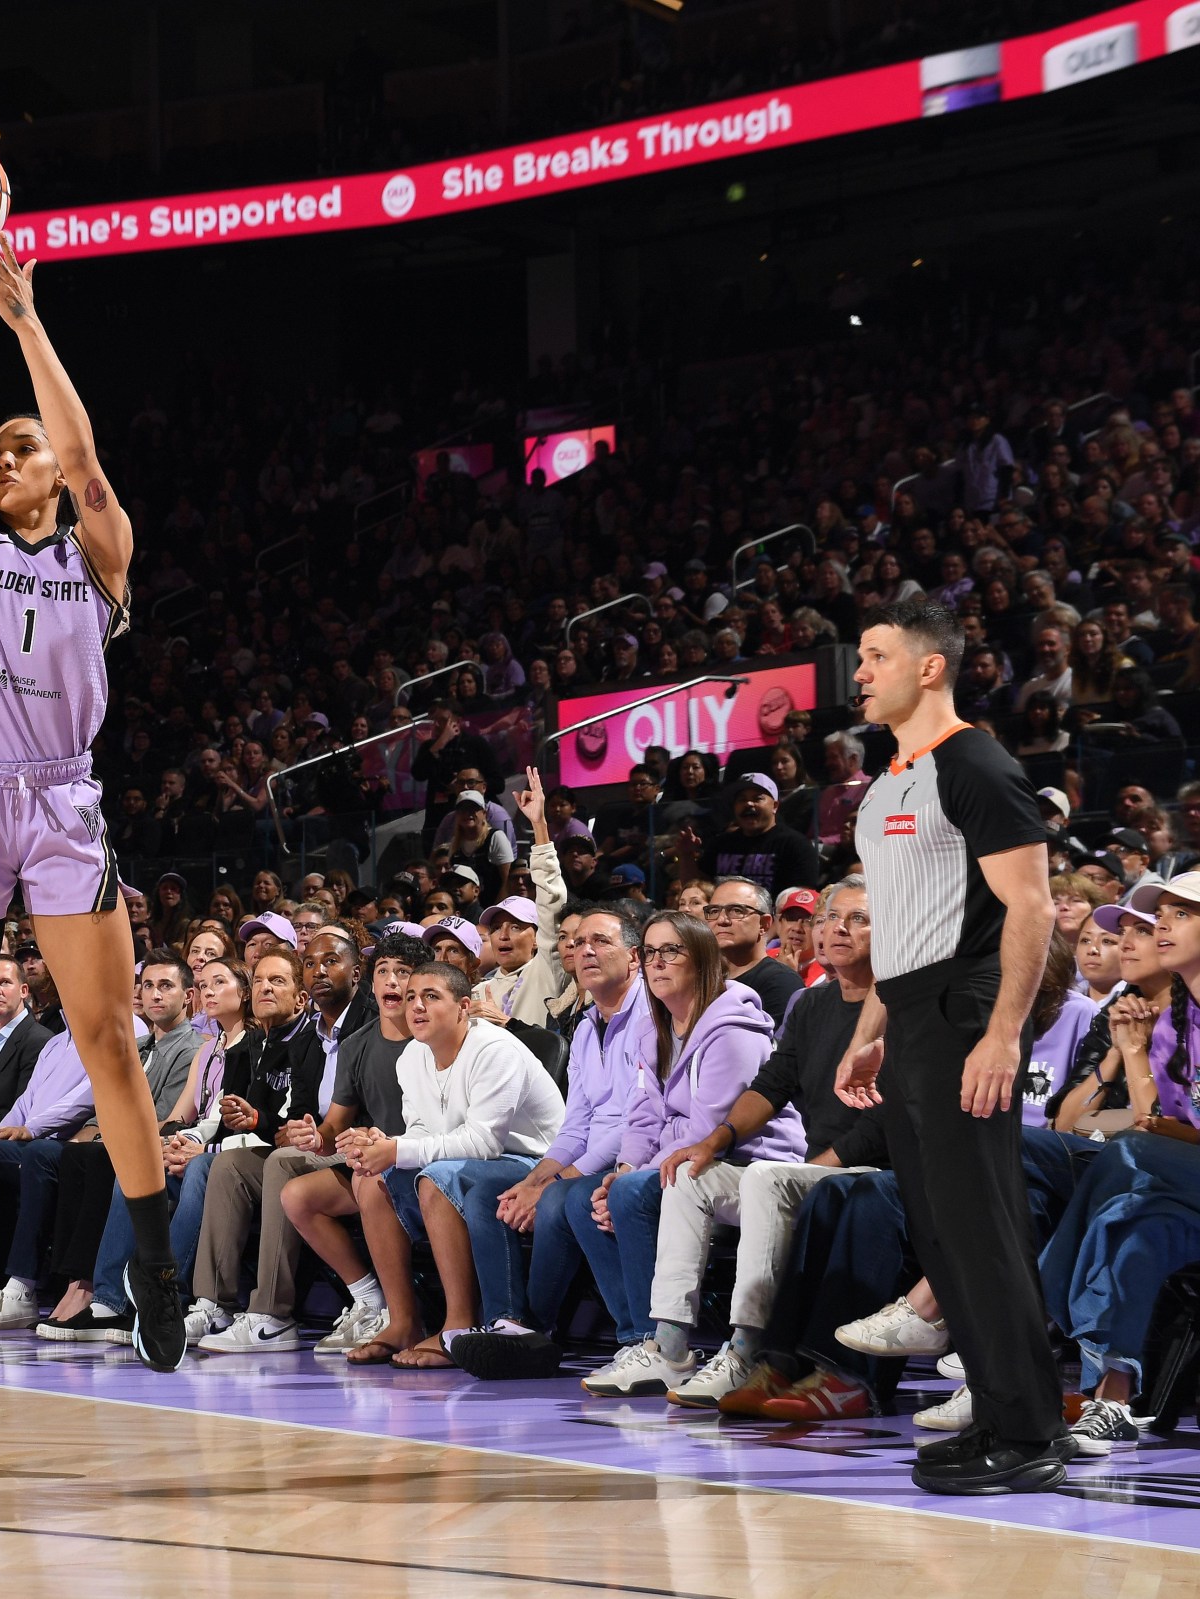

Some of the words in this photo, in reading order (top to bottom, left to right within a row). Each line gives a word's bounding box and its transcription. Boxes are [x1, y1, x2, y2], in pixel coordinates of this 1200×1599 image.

[442, 164, 503, 199] She
[513, 137, 629, 186] Breaks
[638, 99, 791, 158] Through
[46, 212, 138, 248] She’s
[150, 185, 341, 237] Supported
[41, 580, 89, 602] STATE
[20, 608, 37, 655] 1
[624, 694, 738, 765] OLLY
[884, 819, 915, 831] Emirates
[716, 854, 742, 874] WE
[743, 853, 776, 875] ARE
